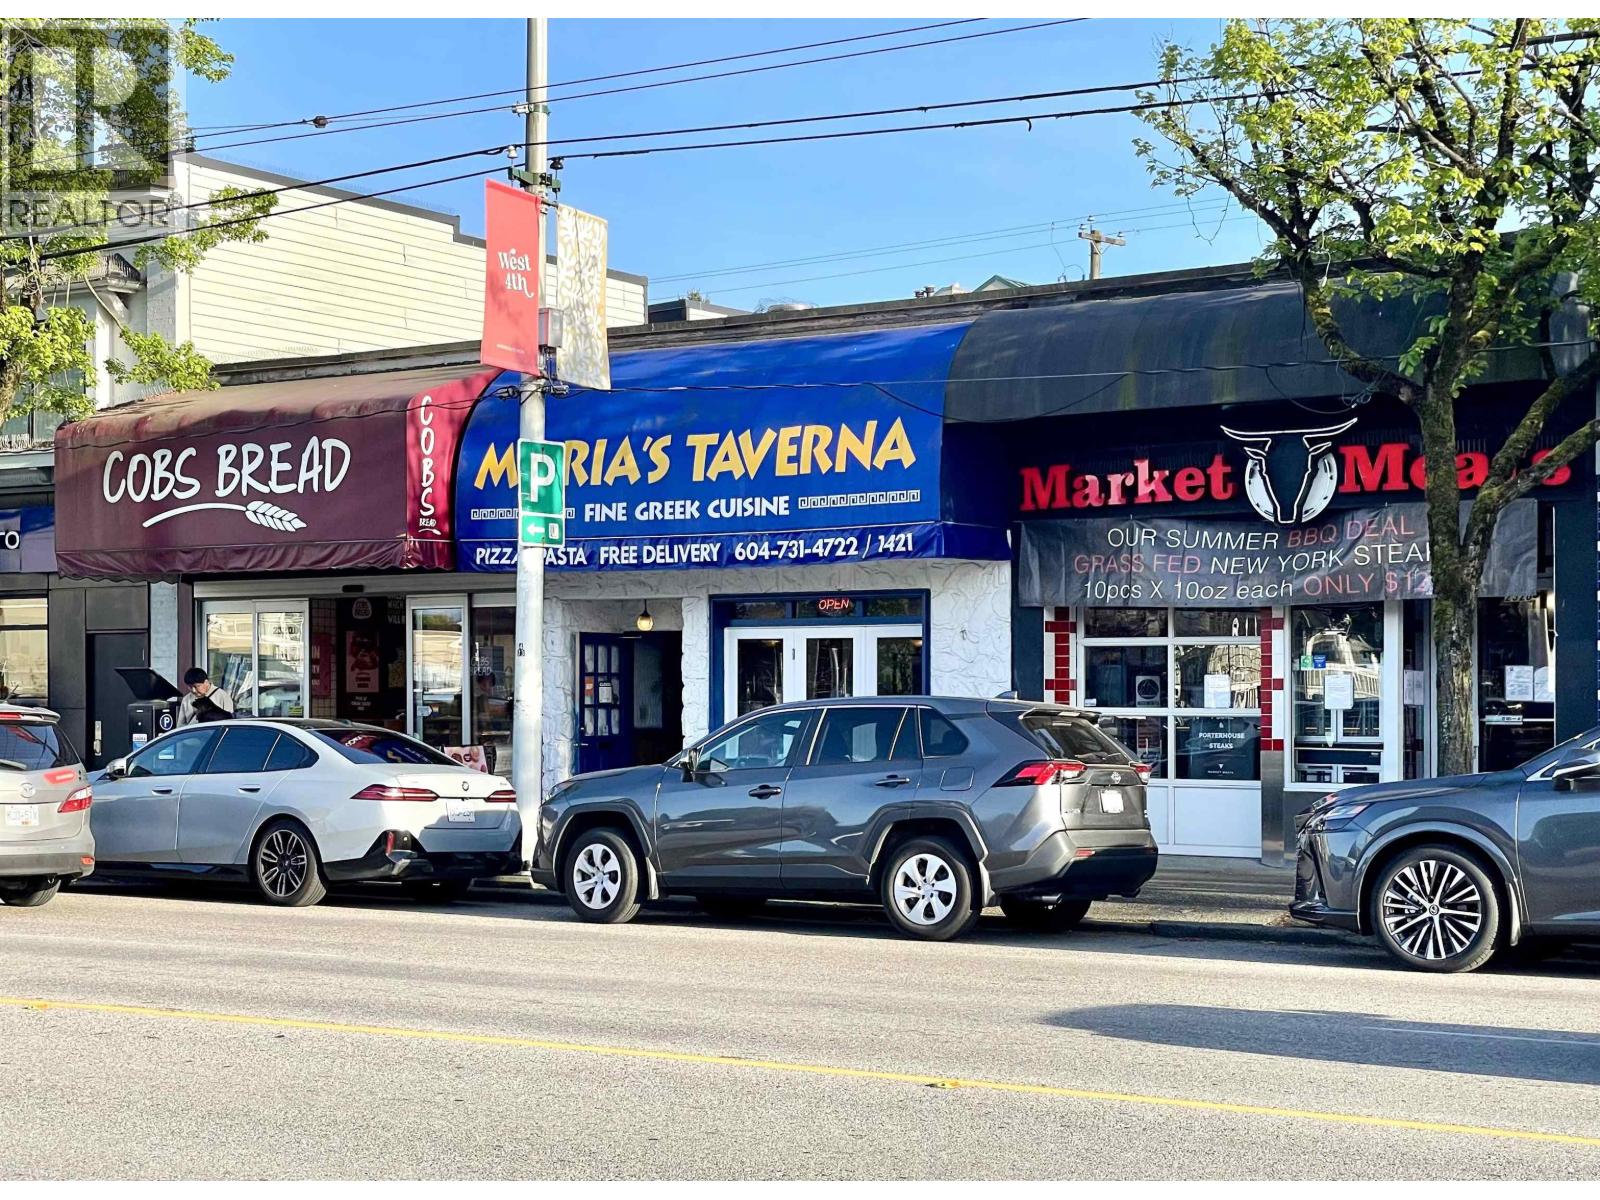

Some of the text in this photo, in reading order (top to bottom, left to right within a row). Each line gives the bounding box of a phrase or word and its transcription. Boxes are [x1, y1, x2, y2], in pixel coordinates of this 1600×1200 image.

[497, 248, 532, 272] West
[505, 273, 535, 298] 4th
[103, 436, 351, 503] COBS BREAD
[419, 395, 435, 517] COBS
[474, 416, 916, 490] MRIA'S TAVERNA
[530, 453, 555, 503] P
[1019, 454, 1236, 511] Market
[584, 496, 790, 522] FINE GREEK CUISINE
[600, 545, 637, 565] FREE
[643, 542, 721, 564] DELIVERY
[735, 537, 858, 560] 604-731-4722
[862, 534, 871, 559] /
[878, 533, 913, 553] 1421
[1107, 516, 1415, 550] OUR SUMMER BBQ DEAL
[1074, 554, 1145, 575] GRASS
[1153, 555, 1201, 574] FED
[1210, 556, 1270, 575] NEW
[1278, 547, 1345, 573] YORK
[1084, 580, 1142, 604] 10pcs
[1150, 580, 1164, 599] X
[1175, 581, 1226, 600] 10oz
[1236, 579, 1293, 600] each
[1304, 571, 1375, 596] ONLY
[818, 599, 849, 610] OPEN
